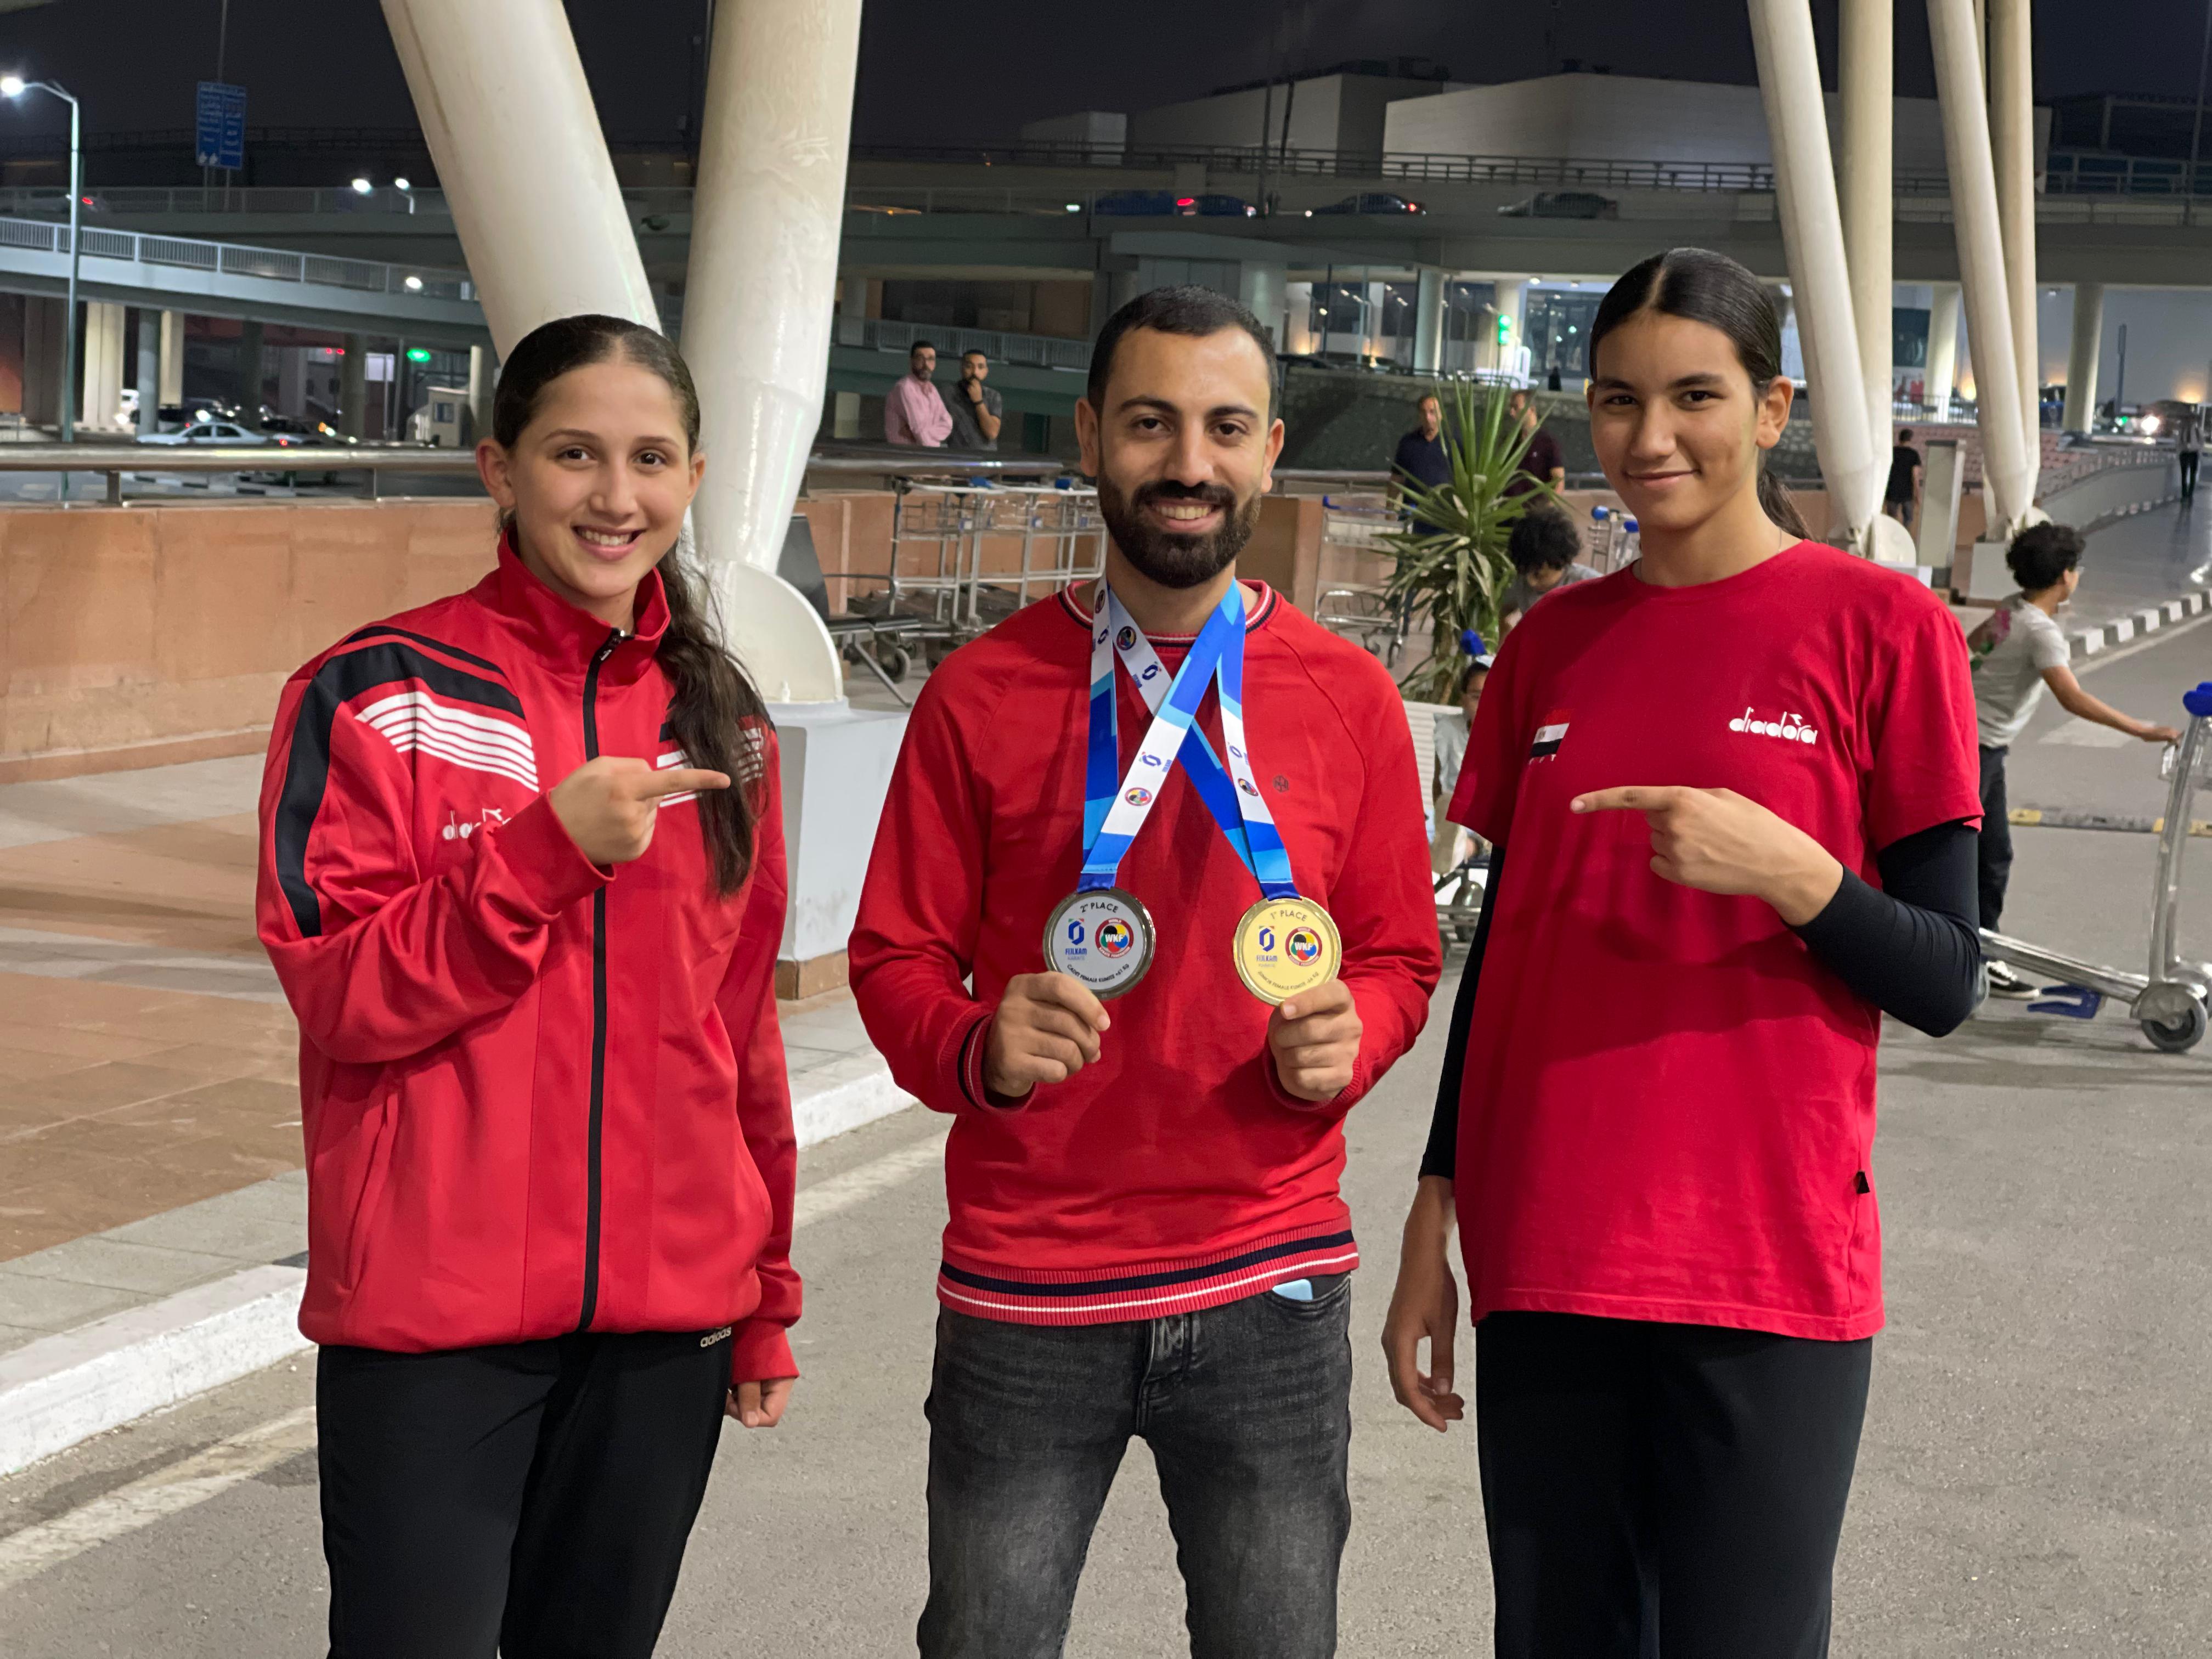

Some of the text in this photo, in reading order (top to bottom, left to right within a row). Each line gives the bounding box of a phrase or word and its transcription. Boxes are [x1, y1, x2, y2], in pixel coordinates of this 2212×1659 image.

[1729, 706, 1818, 745] diadora
[1091, 902, 1119, 913] PLACE
[1280, 910, 1307, 922] PLACE
[1105, 934, 1124, 943] WKF
[1294, 942, 1312, 951] WKF
